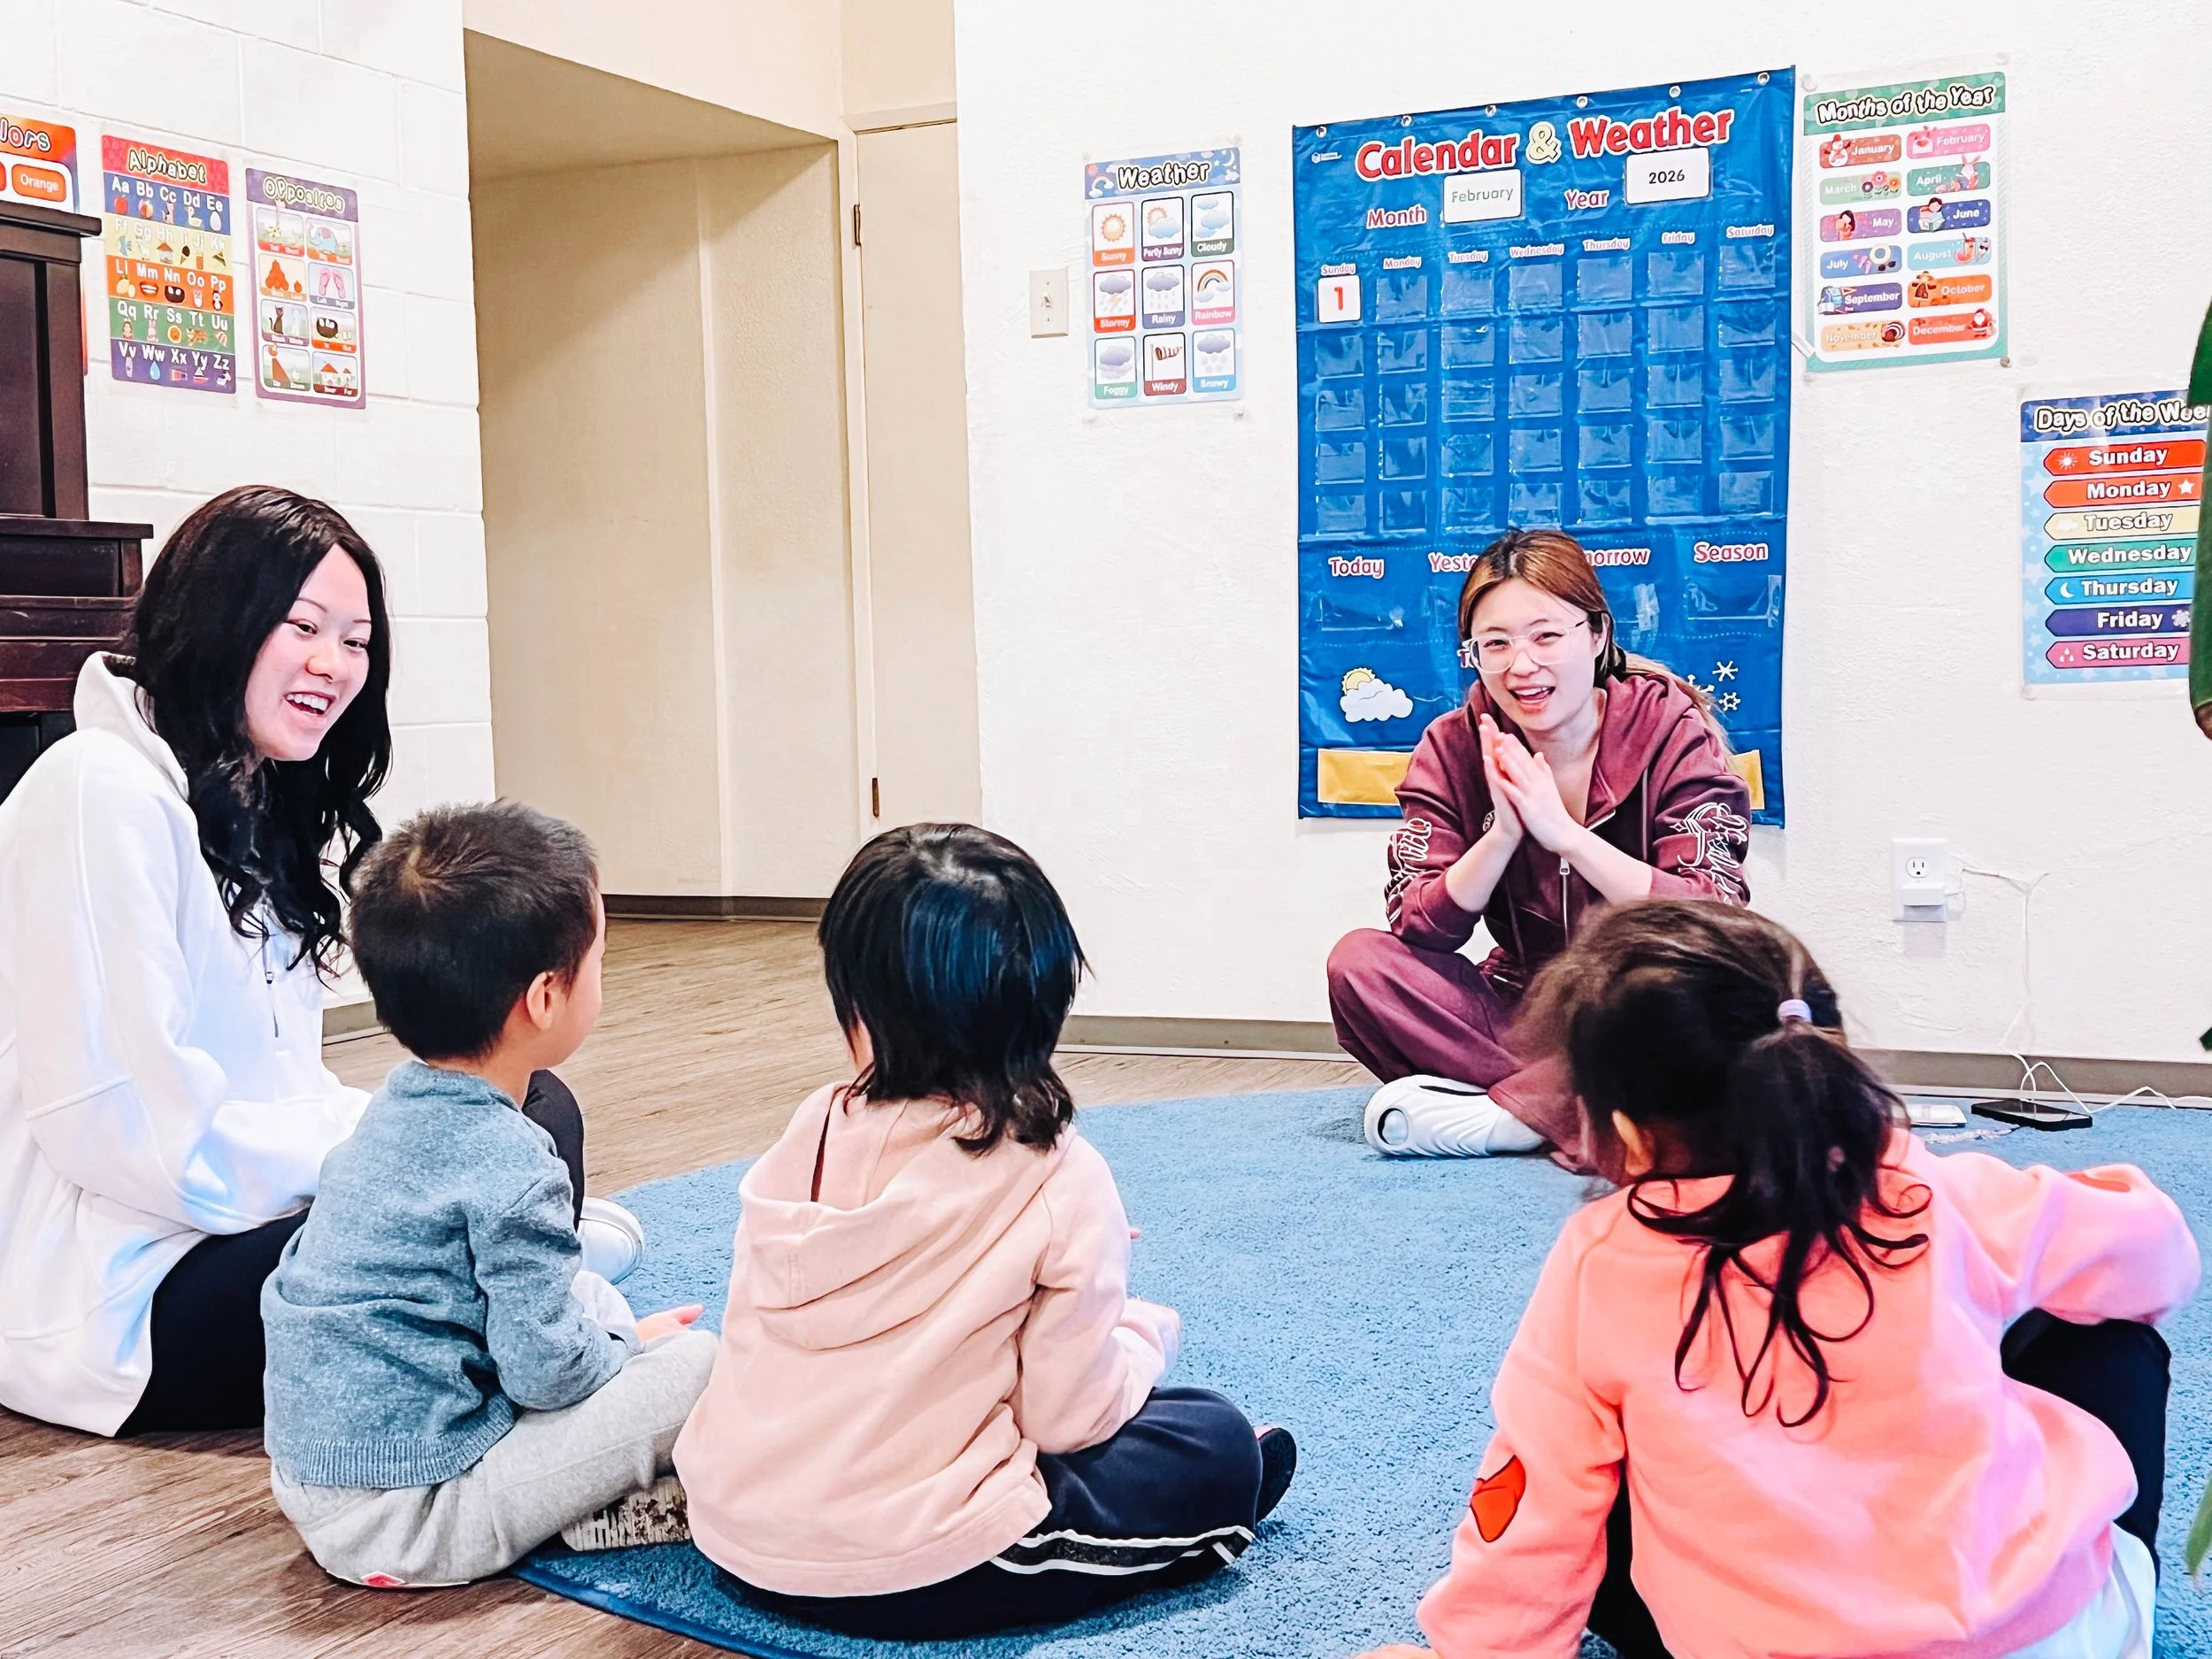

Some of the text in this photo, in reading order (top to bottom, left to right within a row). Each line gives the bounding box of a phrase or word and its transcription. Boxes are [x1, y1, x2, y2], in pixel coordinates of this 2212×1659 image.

[1818, 86, 1993, 123] Months of the Year
[1356, 107, 1733, 180] Calendar & Weather
[1937, 133, 1985, 146] February
[1852, 143, 1894, 156] January
[128, 150, 206, 183] Alphabet
[19, 173, 59, 193] Orange
[1118, 162, 1210, 189] Weather
[1648, 169, 1685, 184] 2026
[1916, 174, 1941, 187] April
[111, 176, 223, 212] Aa Bb Cc Dd Ee
[1452, 188, 1513, 204] February
[1824, 183, 1857, 195] March
[1565, 190, 1609, 209] Year
[1368, 205, 1426, 228] Month
[1953, 209, 1980, 219] June
[1872, 218, 1894, 228] May
[1662, 233, 1694, 244] Friday
[1726, 225, 1774, 238] Saturday
[1196, 241, 1227, 253] Cloudy
[1510, 242, 1564, 257] Wednesday
[1583, 238, 1630, 251] Thursday
[1101, 250, 1127, 262] Sunny
[1384, 257, 1422, 269] Monday
[1448, 251, 1488, 264] Tuesday
[1914, 250, 1952, 262] August
[1322, 265, 1356, 275] Sunday
[1826, 259, 1849, 271] July
[136, 263, 158, 280] Mm
[164, 268, 180, 283] Nn
[187, 271, 204, 288] Oo
[211, 275, 227, 293] Pp
[1941, 284, 1985, 296] October
[1333, 287, 1345, 311] 1
[1845, 291, 1901, 306] September
[118, 301, 228, 331] Qq Rr Ss Tt Uu
[1151, 314, 1176, 325] Rainy
[1194, 310, 1233, 320] Rainbow
[1100, 318, 1131, 328] Stormy
[1913, 323, 1966, 335] December
[1825, 330, 1878, 343] November
[119, 342, 230, 371] Vv Ww Xx Yy Zz
[1103, 384, 1129, 396] Foggy
[1151, 380, 1179, 392] Windy
[1200, 379, 1229, 389] Snowy
[2038, 408, 2087, 432] Days
[2093, 406, 2116, 426] of
[2119, 403, 2154, 423] the
[2088, 447, 2169, 466] Sunday
[2086, 480, 2171, 500] Monday
[2084, 512, 2173, 532] Tuesday
[1694, 541, 1769, 563] Season
[2068, 544, 2193, 565] Wednesday
[1330, 556, 1384, 579] Today
[2081, 577, 2178, 596] Thursday
[2097, 611, 2163, 629] Friday
[2082, 641, 2181, 661] Saturday
